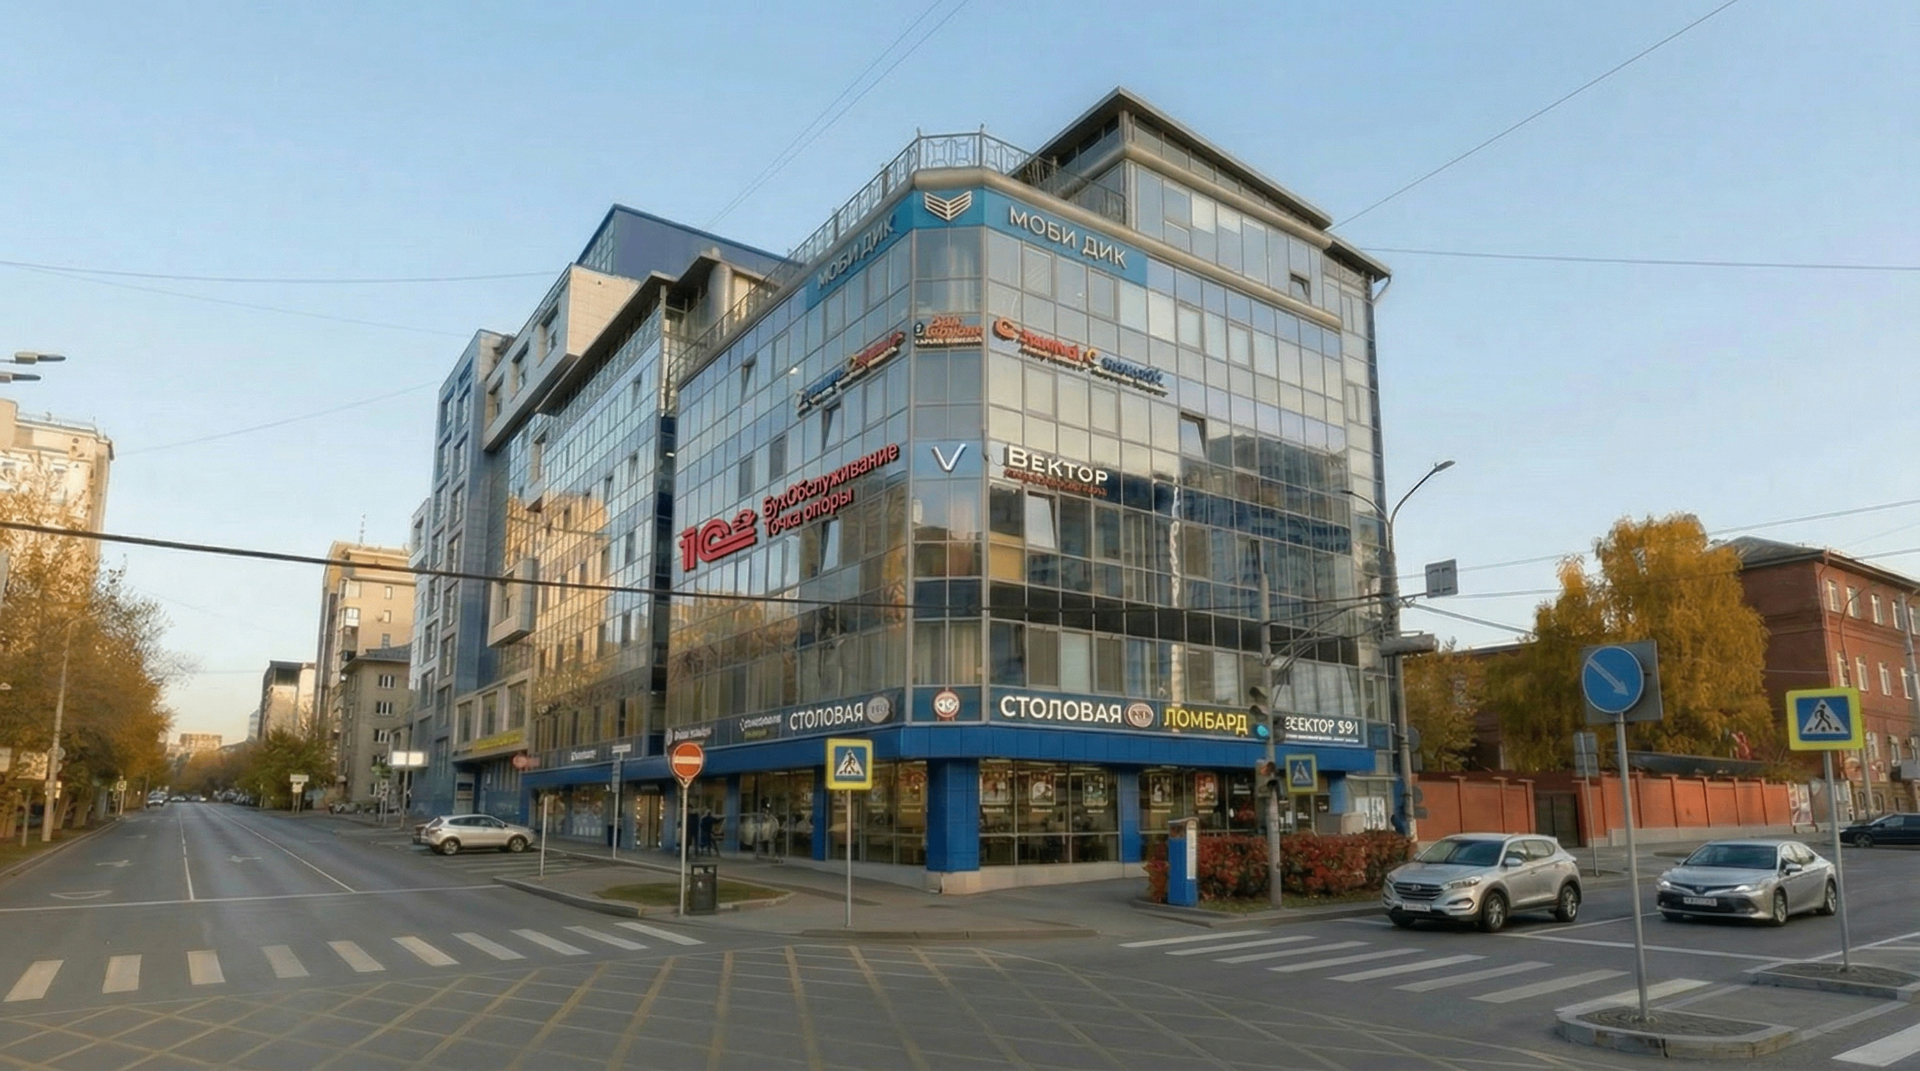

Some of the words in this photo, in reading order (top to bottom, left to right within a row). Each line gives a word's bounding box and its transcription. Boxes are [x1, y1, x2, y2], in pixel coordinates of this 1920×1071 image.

[817, 244, 859, 291] МОБИ
[860, 213, 895, 259] ДИК
[1009, 205, 1077, 249] МОБИ
[1082, 235, 1127, 269] ДИК
[762, 442, 900, 517] БухОбслуживание
[763, 509, 801, 538] Точка
[803, 487, 854, 521] опоры
[789, 701, 864, 731] СТОЛОВАЯ
[1000, 695, 1122, 724] СТОЛОВАЯ
[1164, 706, 1248, 737] ЛОМБАРД
